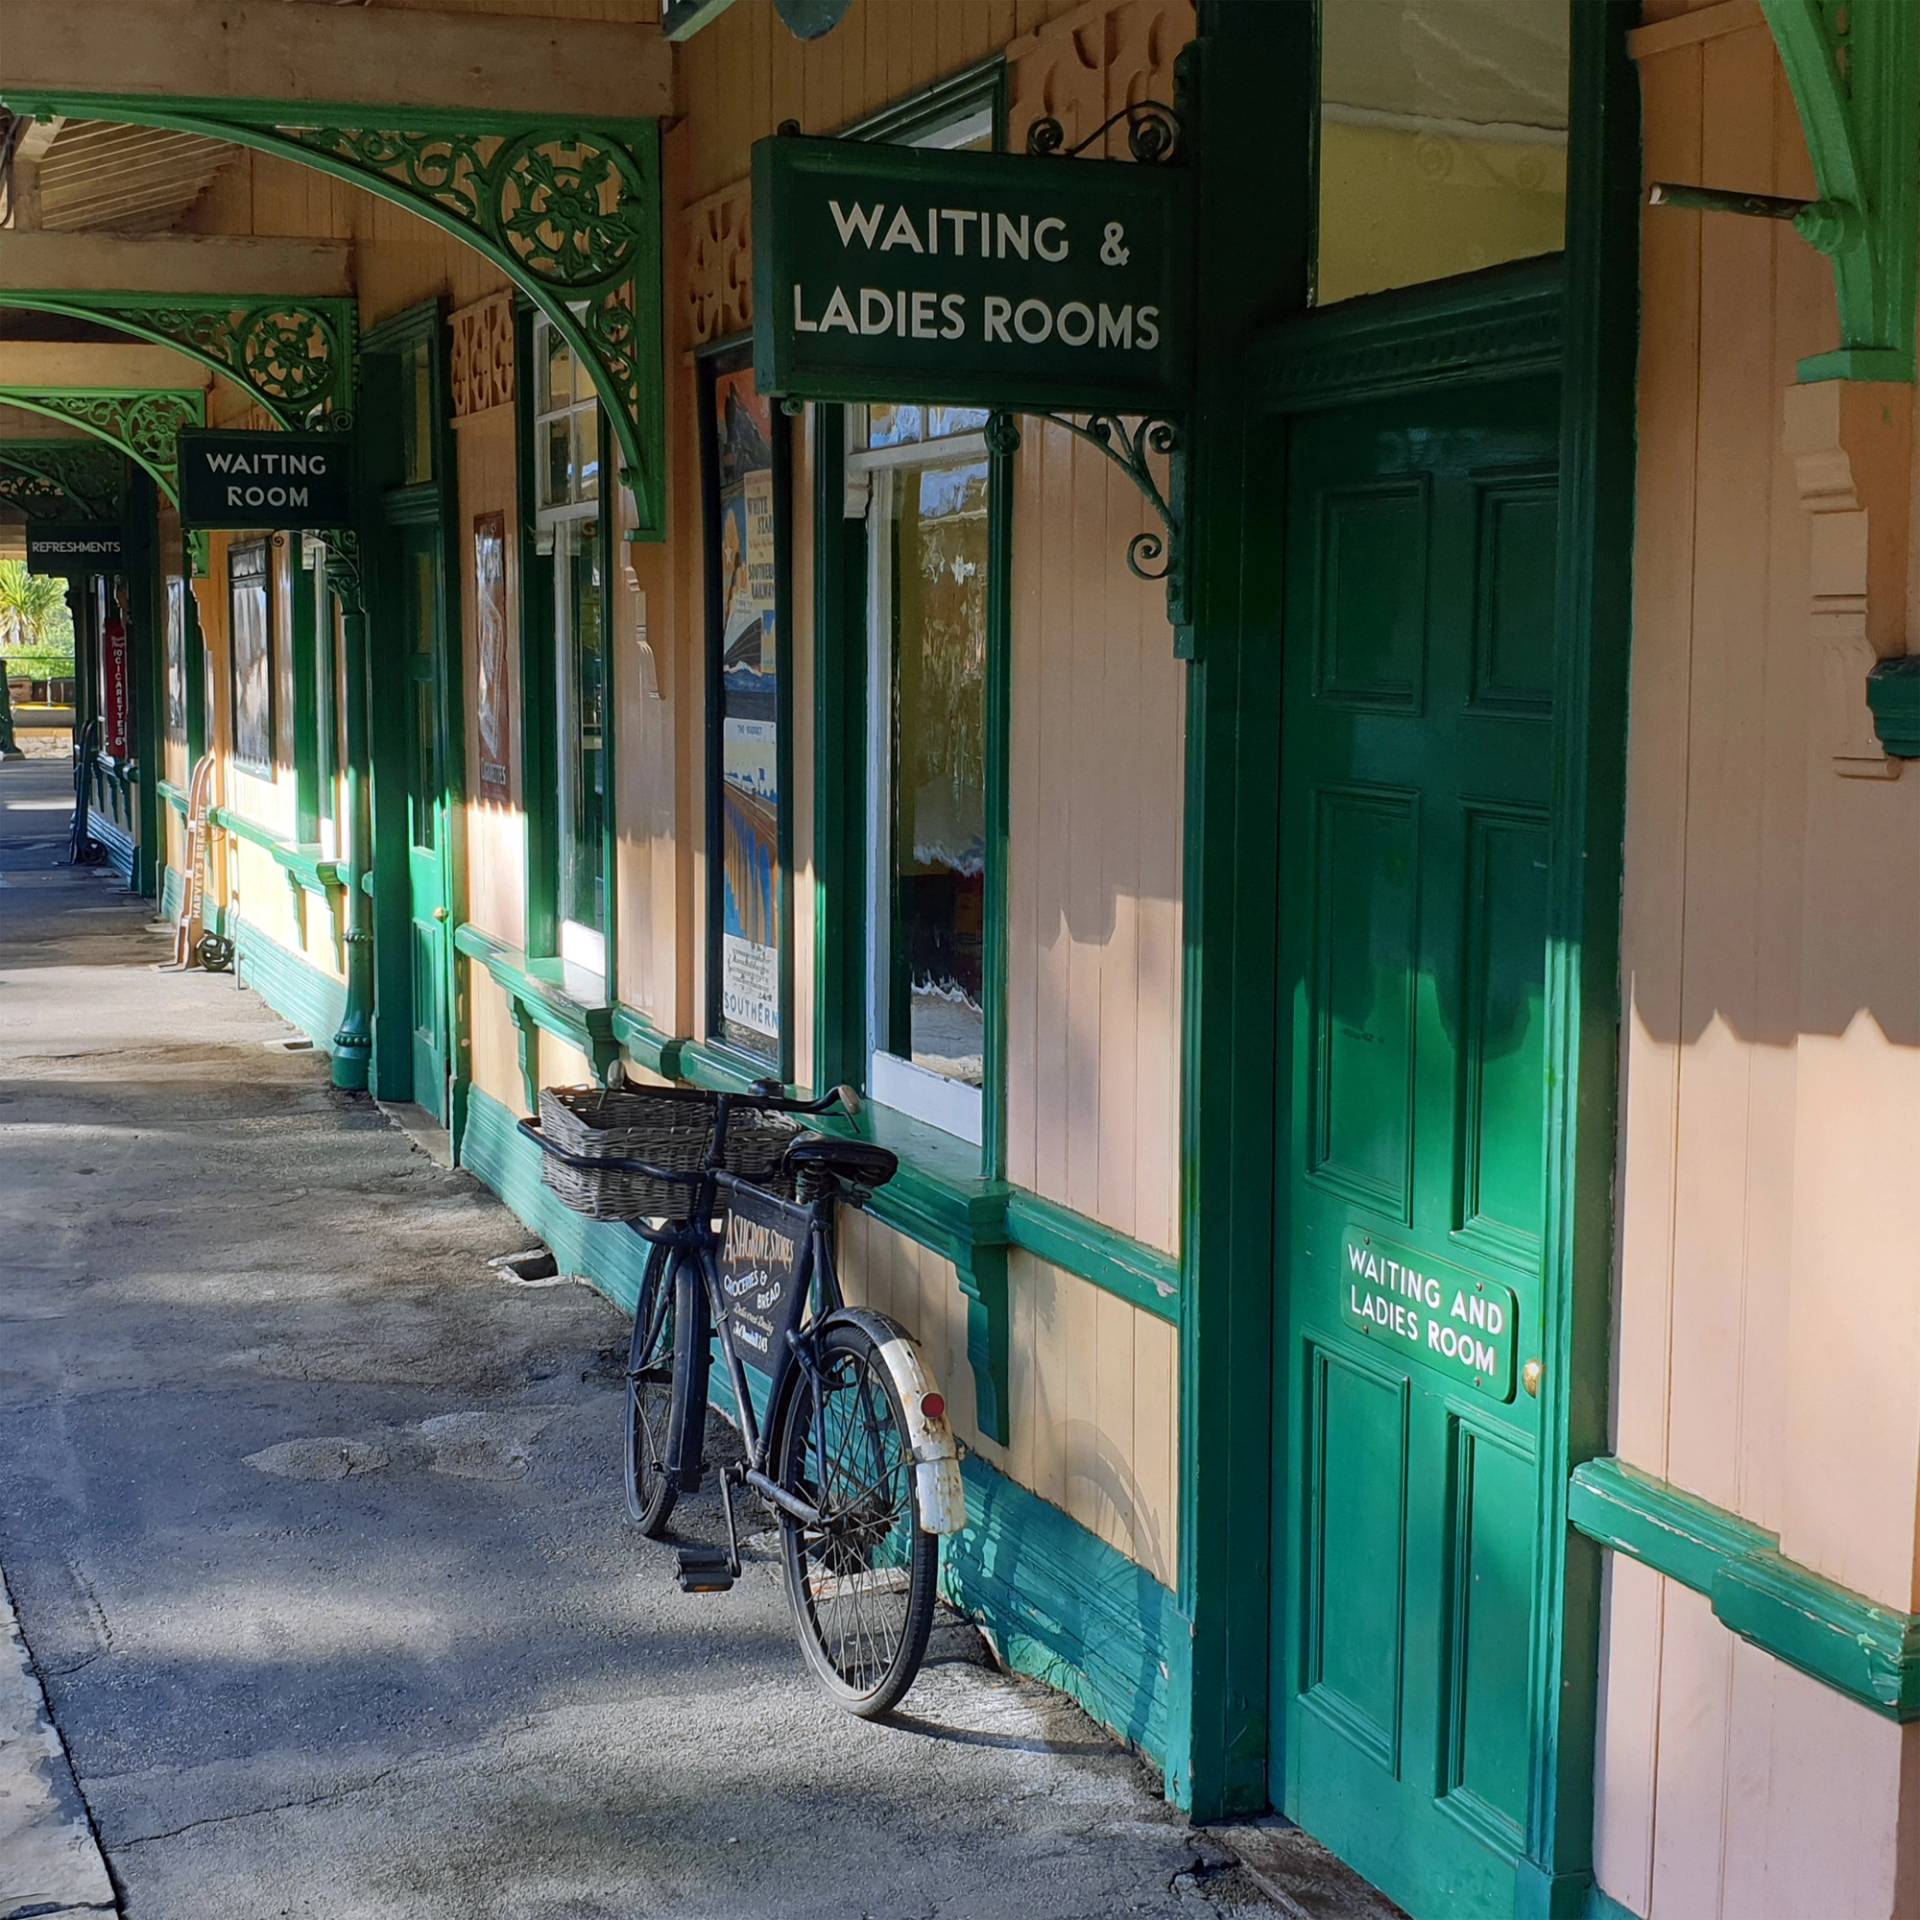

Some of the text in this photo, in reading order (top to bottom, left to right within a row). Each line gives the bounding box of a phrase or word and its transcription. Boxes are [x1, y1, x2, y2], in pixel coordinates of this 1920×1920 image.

[829, 200, 1130, 266] WAITING &
[794, 283, 1160, 351] LADIES ROOMS
[206, 453, 326, 475] WAITING
[227, 486, 308, 507] ROOM
[32, 541, 121, 553] REFRESHMENTS
[724, 991, 779, 1029] SOUTHERN
[757, 1282, 781, 1310] BREAD
[1348, 1243, 1503, 1335] WAITING AND
[1351, 1284, 1494, 1376] LADIES ROOM
